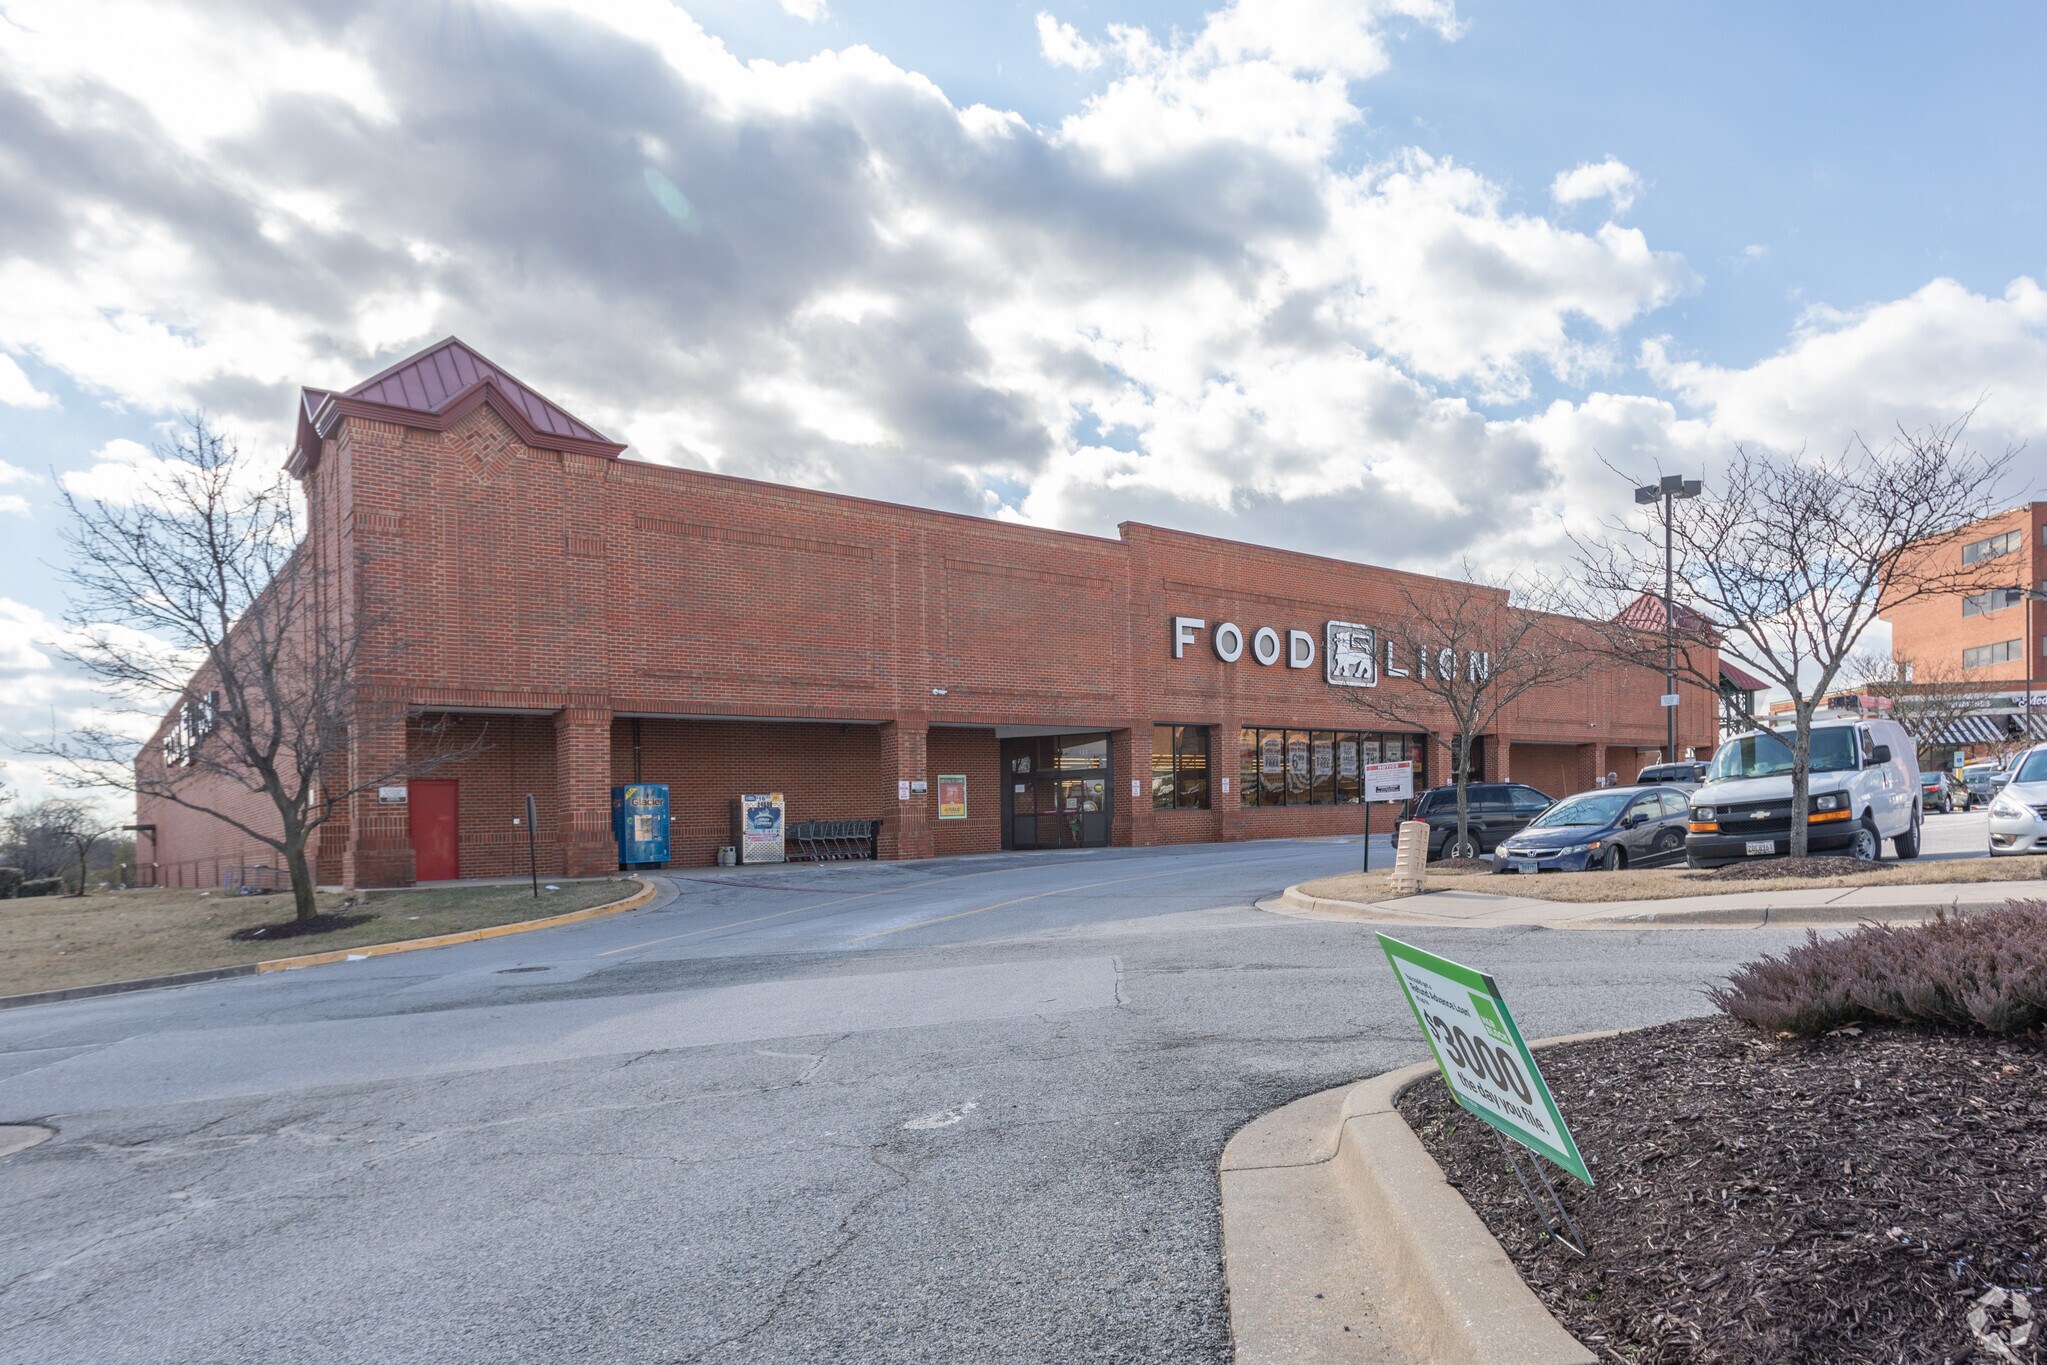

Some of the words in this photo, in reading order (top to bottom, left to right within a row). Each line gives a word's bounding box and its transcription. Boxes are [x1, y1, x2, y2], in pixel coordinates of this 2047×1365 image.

[1174, 616, 1315, 668] FOOD
[1386, 640, 1488, 683] LION
[631, 798, 664, 807] Glacier
[1429, 991, 1455, 1010] Advance
[1423, 1009, 1533, 1105] $3000
[1456, 1071, 1478, 1094] the
[1478, 1082, 1501, 1110] day
[1499, 1096, 1524, 1120] you
[1520, 1105, 1551, 1136] file.
